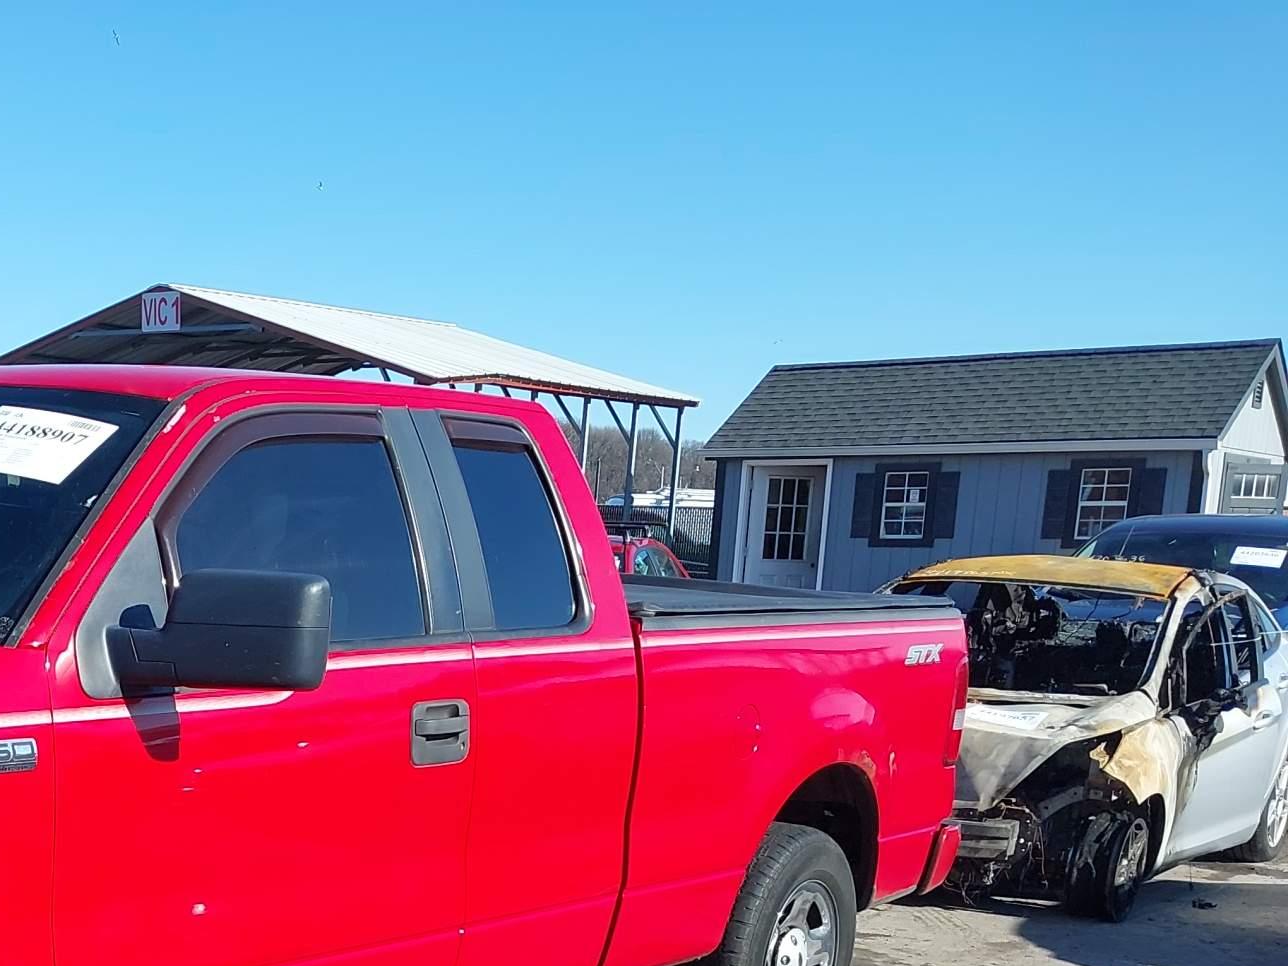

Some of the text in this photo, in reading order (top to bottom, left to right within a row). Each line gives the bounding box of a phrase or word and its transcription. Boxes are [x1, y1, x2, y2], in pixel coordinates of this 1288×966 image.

[143, 296, 179, 327] VIC 1
[904, 643, 944, 666] STX
